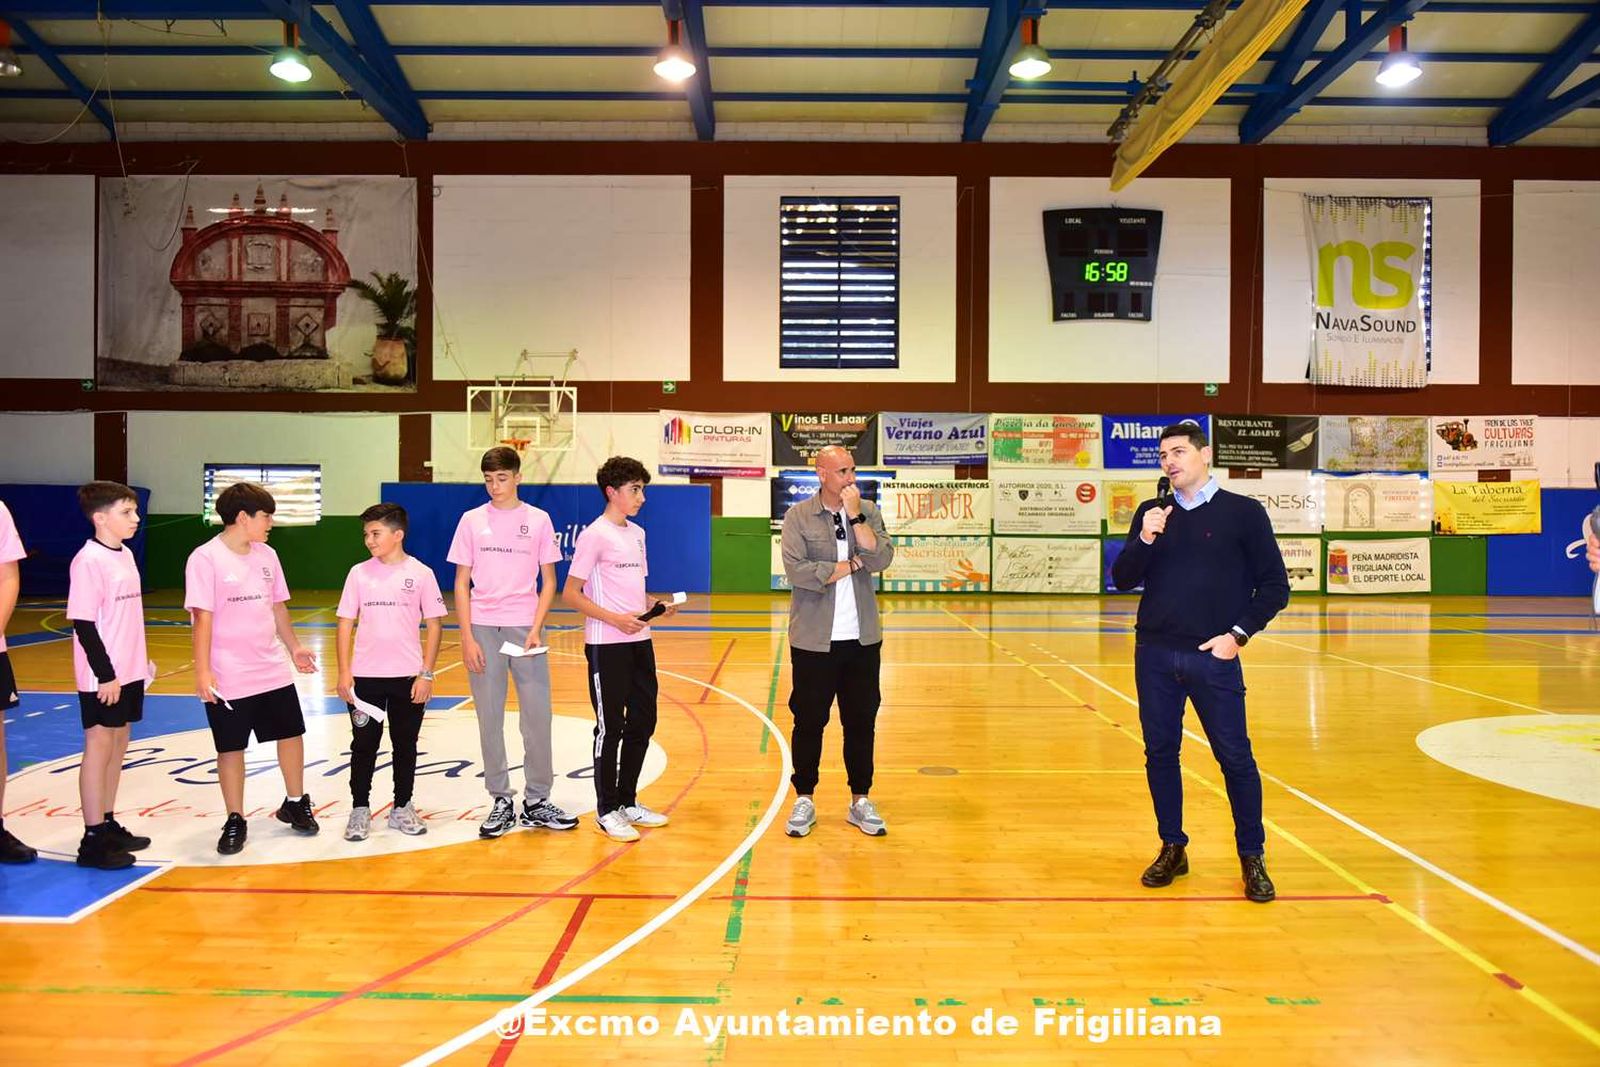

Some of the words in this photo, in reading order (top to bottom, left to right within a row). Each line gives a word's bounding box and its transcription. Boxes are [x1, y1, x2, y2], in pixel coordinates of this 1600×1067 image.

[1085, 262, 1128, 281] 16:58
[821, 414, 832, 424] El
[899, 418, 934, 429] Viajes
[1218, 419, 1273, 428] RESTAURANTE
[694, 425, 763, 435] COLOR-IN
[885, 426, 943, 440] Verano
[947, 425, 985, 440] Azul
[1249, 429, 1281, 437] ADARVE
[1484, 427, 1534, 440] CULTURAS
[704, 435, 752, 443] PINTURAS
[1484, 439, 1534, 448] FRIGILIANA
[1452, 485, 1467, 495] La
[1469, 484, 1522, 495] Taberna
[896, 492, 974, 520] INELSUR
[1352, 552, 1373, 561] PEÑA
[1374, 552, 1419, 561] MADRIDISTA
[1352, 564, 1393, 572] FRIGILIANA
[1395, 563, 1412, 571] CON
[1364, 574, 1399, 582] DEPORTE
[1401, 573, 1426, 581] LOCAL
